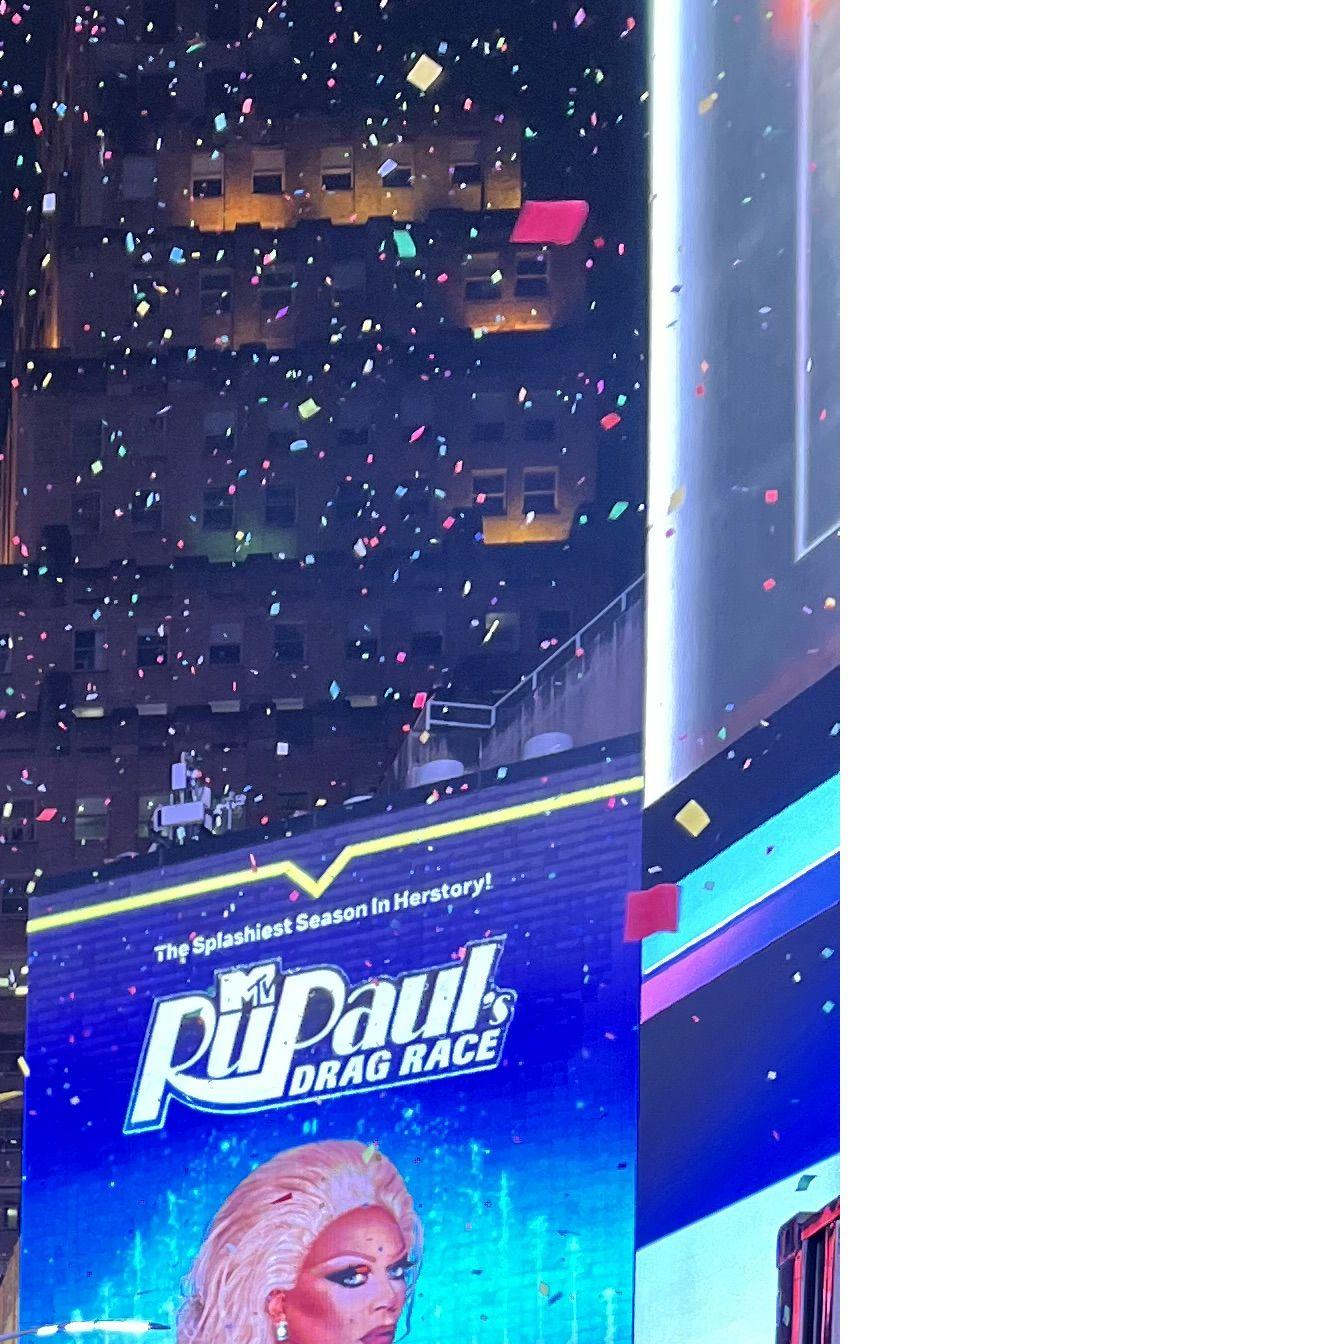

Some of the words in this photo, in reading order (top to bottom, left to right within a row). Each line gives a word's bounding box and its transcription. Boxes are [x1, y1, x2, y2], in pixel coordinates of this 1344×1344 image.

[154, 938, 190, 964] The
[191, 917, 293, 956] Splashiest
[295, 900, 369, 932] Season
[371, 897, 390, 915] In
[392, 872, 493, 910] Herstory!
[220, 962, 276, 1011] MTV
[128, 940, 512, 1130] RuPaul's
[289, 1051, 390, 1097] DRAG
[399, 1028, 500, 1076] RACE
